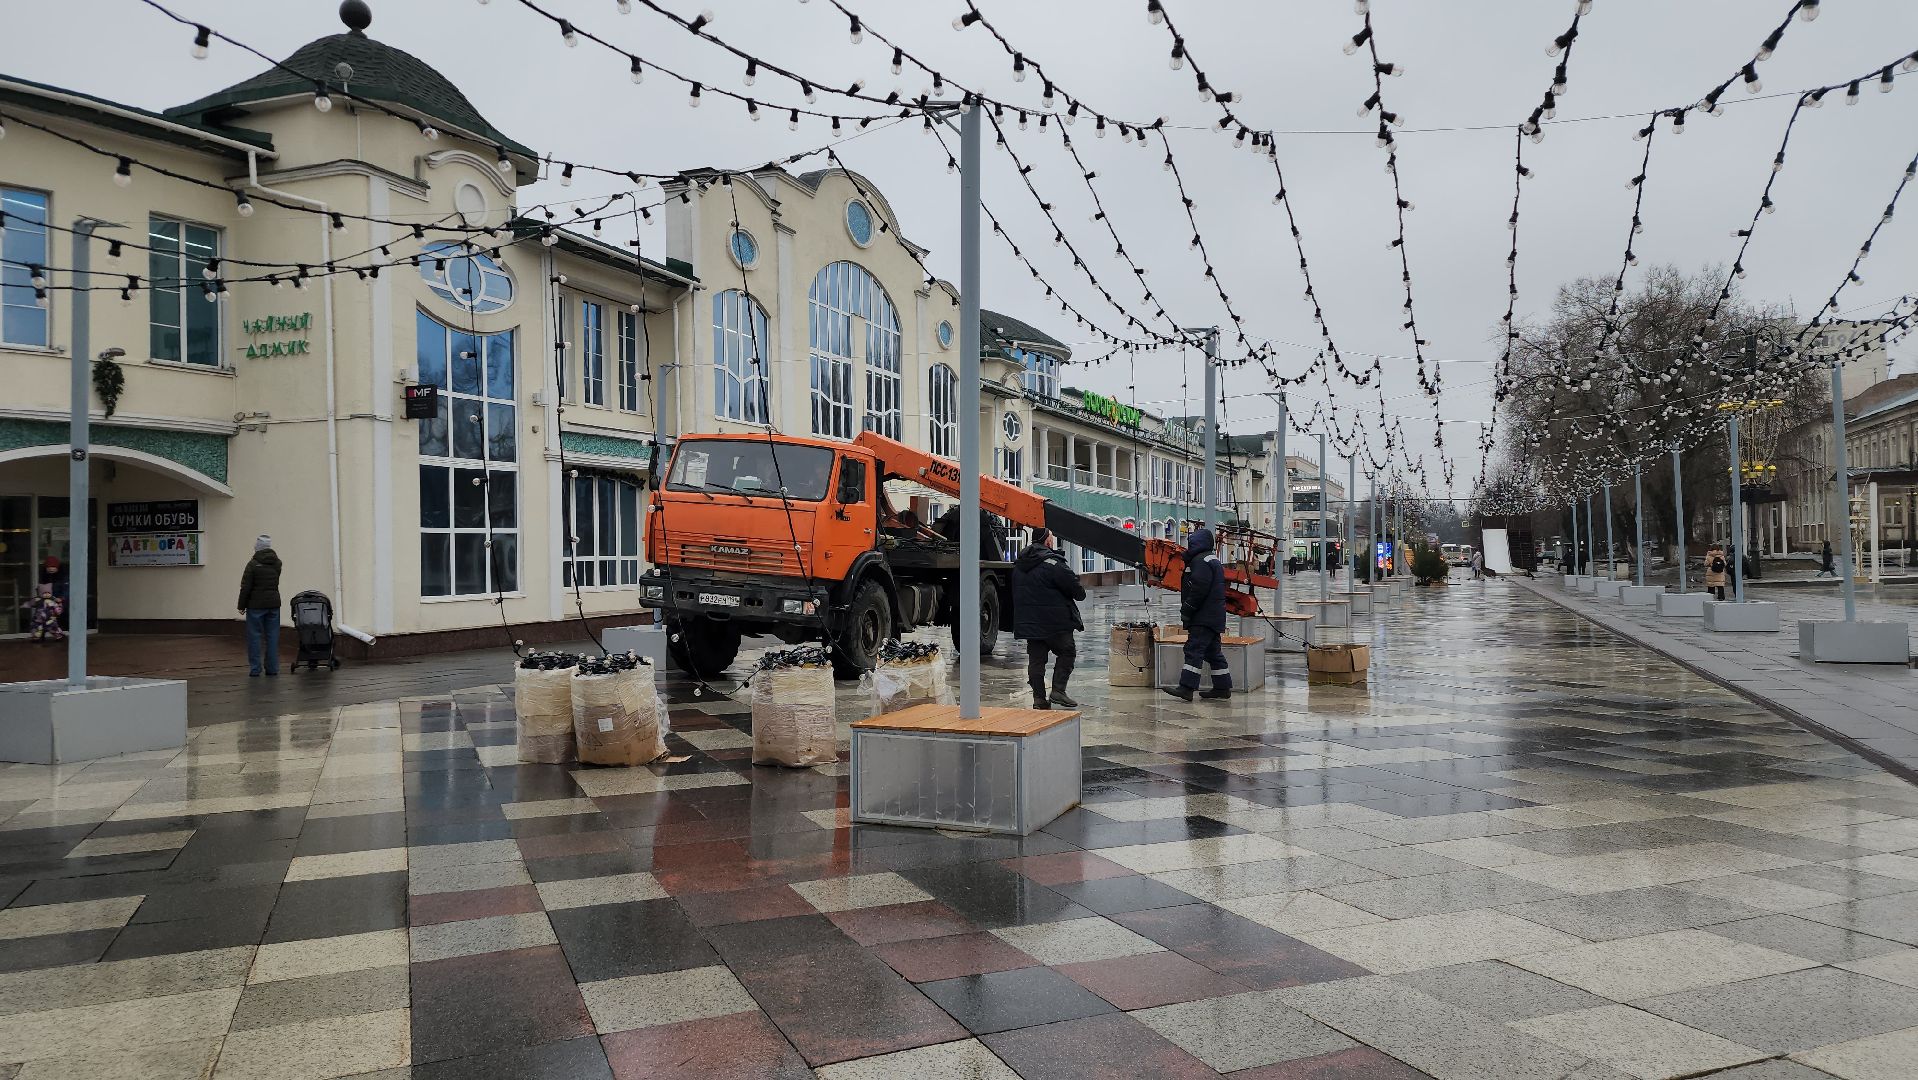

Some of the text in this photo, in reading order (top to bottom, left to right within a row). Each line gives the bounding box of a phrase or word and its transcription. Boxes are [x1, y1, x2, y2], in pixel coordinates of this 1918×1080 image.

[112, 512, 195, 527] СУМКИ ОБУВЬ
[121, 538, 184, 554] ДЕТВОРА
[710, 545, 749, 555] KAMAZ
